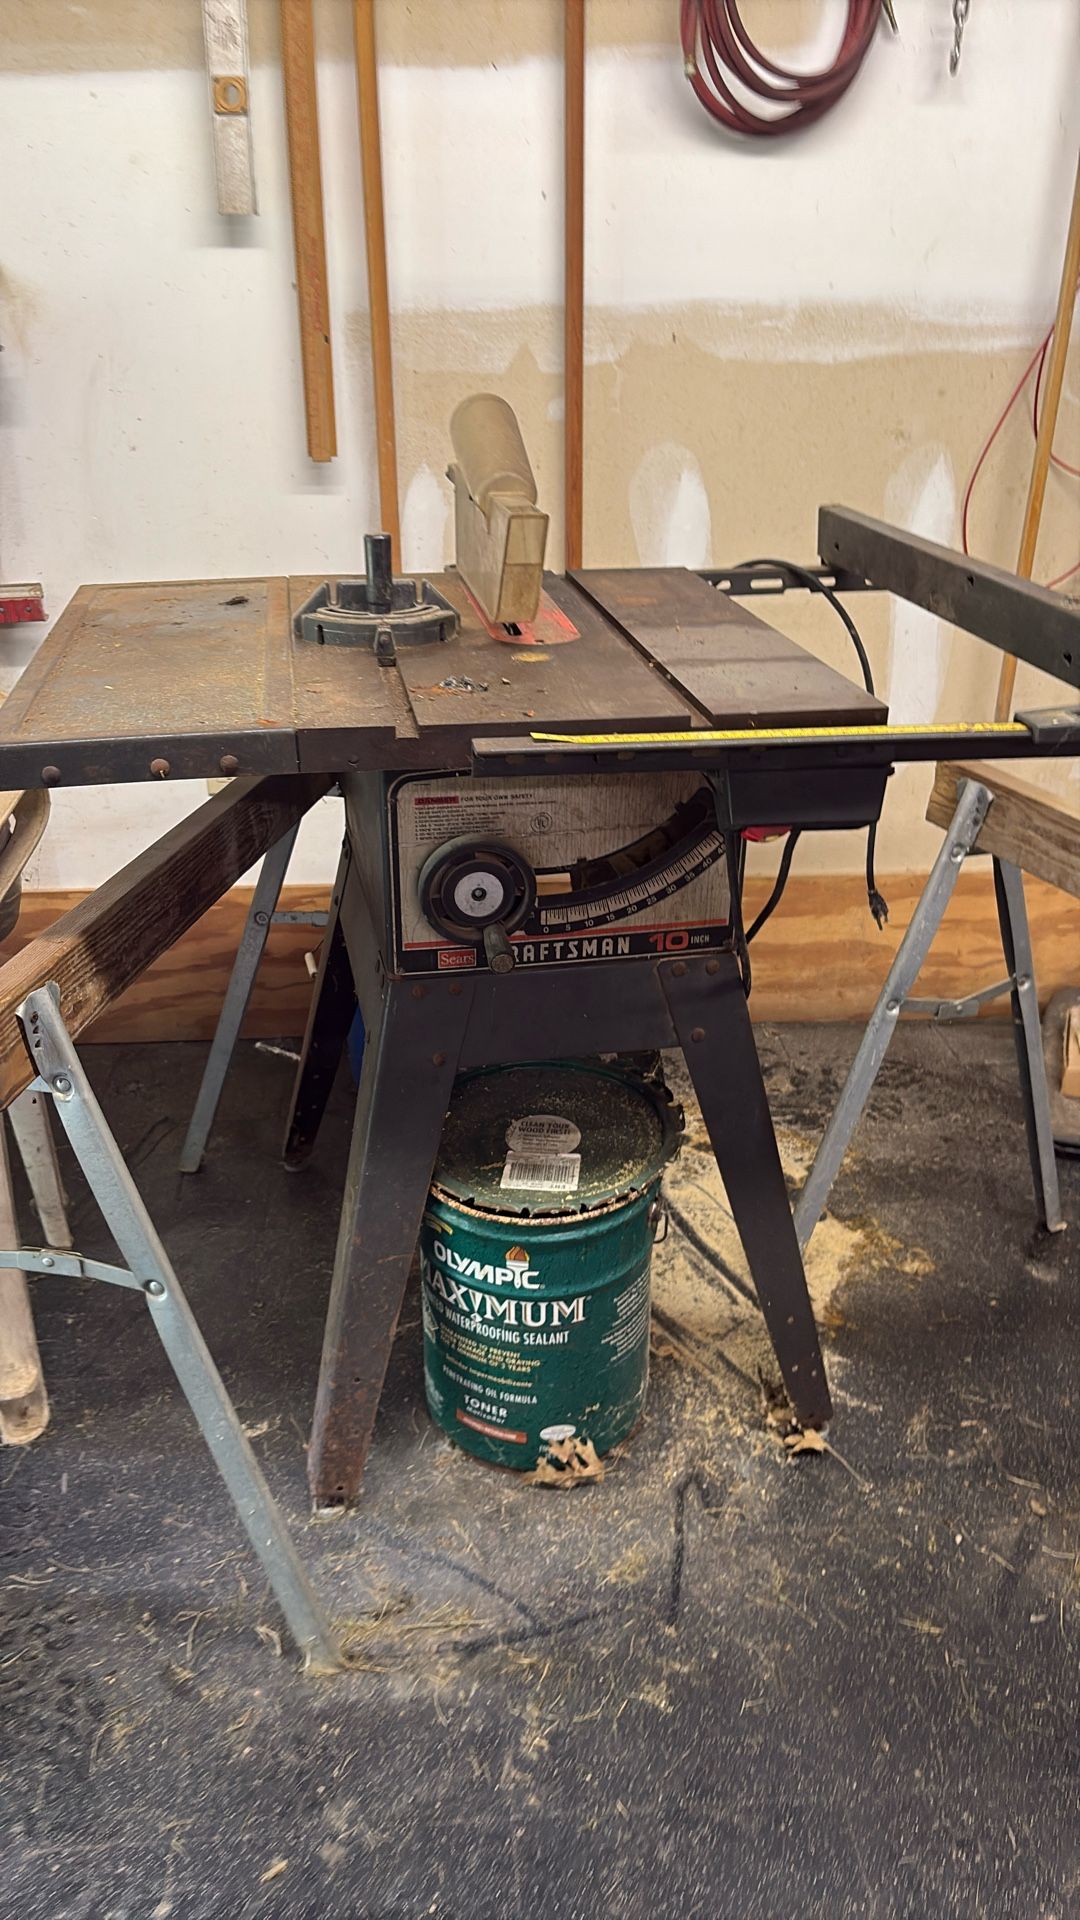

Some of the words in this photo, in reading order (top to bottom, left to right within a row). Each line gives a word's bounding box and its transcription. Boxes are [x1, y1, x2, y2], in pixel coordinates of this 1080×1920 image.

[702, 857, 713, 868] 40
[666, 884, 677, 894] 30
[626, 905, 638, 914] 20
[606, 914, 616, 922] 15
[565, 924, 571, 932] 5
[511, 937, 631, 963] RAFTSMAN
[649, 931, 690, 952] 10
[690, 935, 710, 944] INCH
[440, 953, 474, 967] Sears
[548, 1121, 570, 1129] YOUR
[433, 1240, 540, 1290] OLYMPIC
[445, 1306, 520, 1344] WATERPROOFING
[523, 1330, 569, 1345] SEALANT
[489, 1346, 520, 1358] PREVENT
[508, 1363, 531, 1373] YEARS
[485, 1387, 498, 1399] OIL
[499, 1391, 538, 1405] FORMULA
[464, 1394, 508, 1418] TONER
